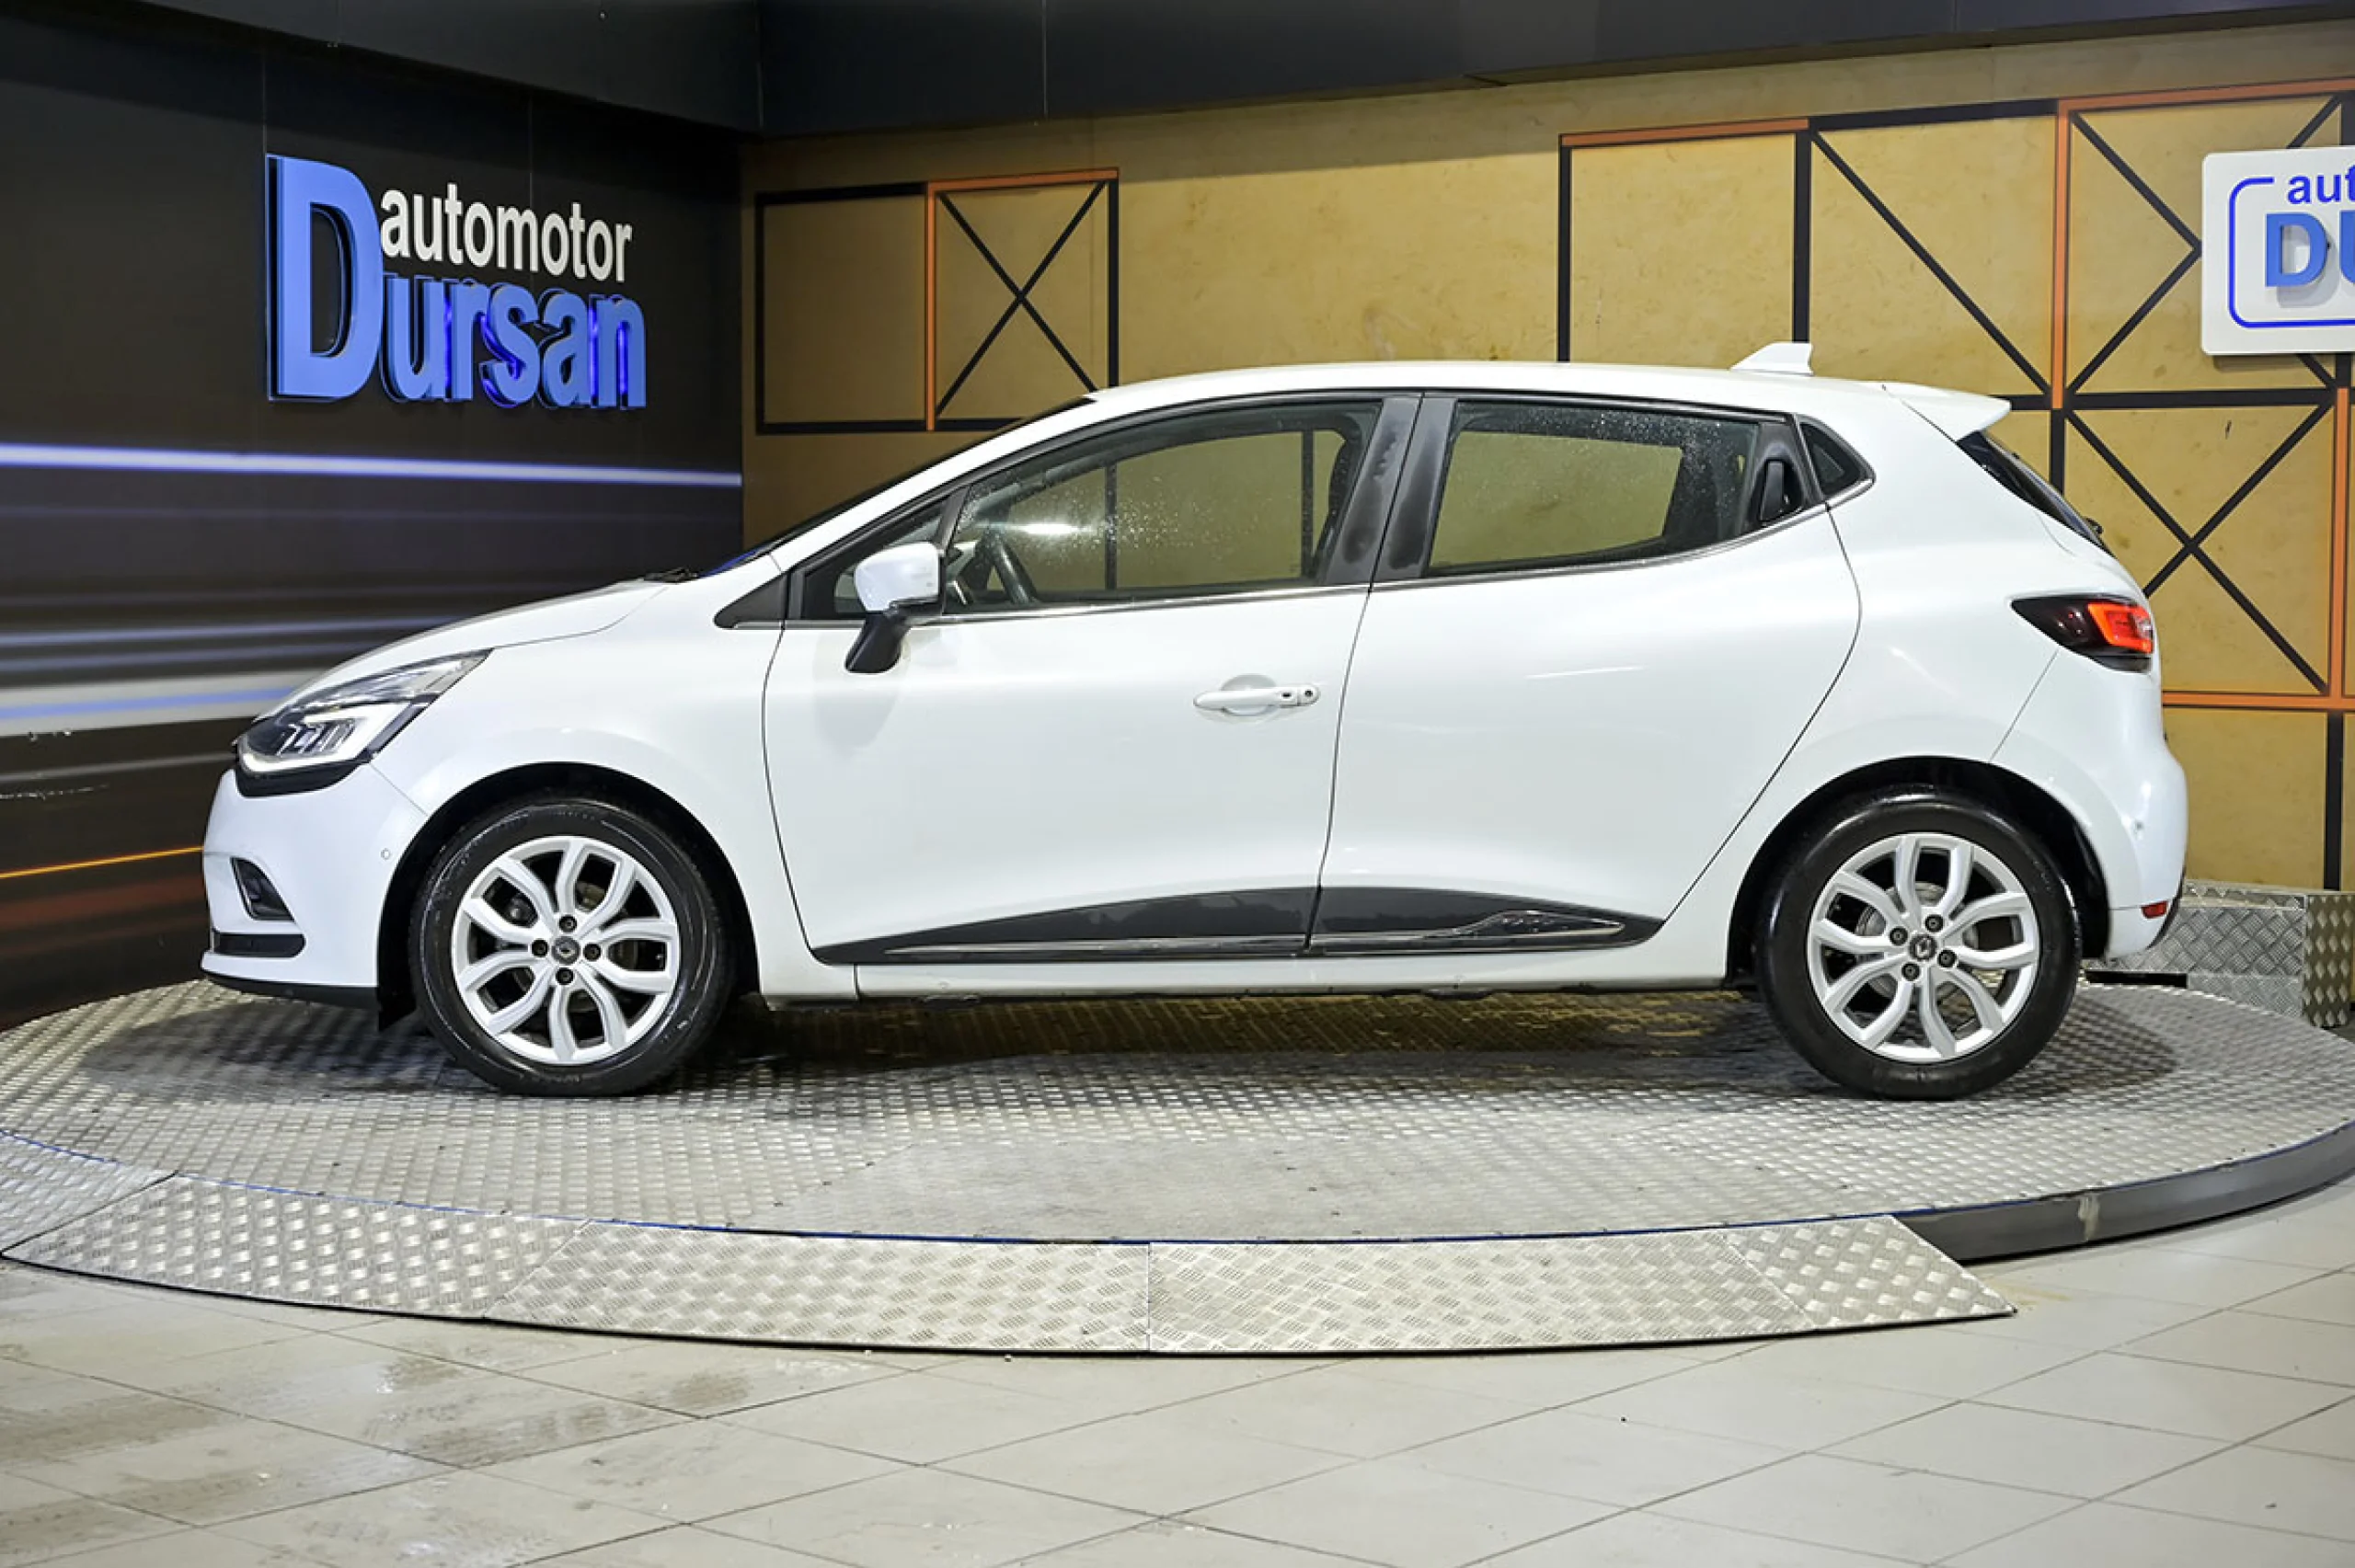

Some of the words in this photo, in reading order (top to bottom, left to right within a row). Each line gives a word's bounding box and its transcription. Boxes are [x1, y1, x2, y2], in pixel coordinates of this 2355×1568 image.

[266, 153, 646, 408] Dursan
[380, 182, 633, 281] automotor
[2265, 210, 2355, 288] D
